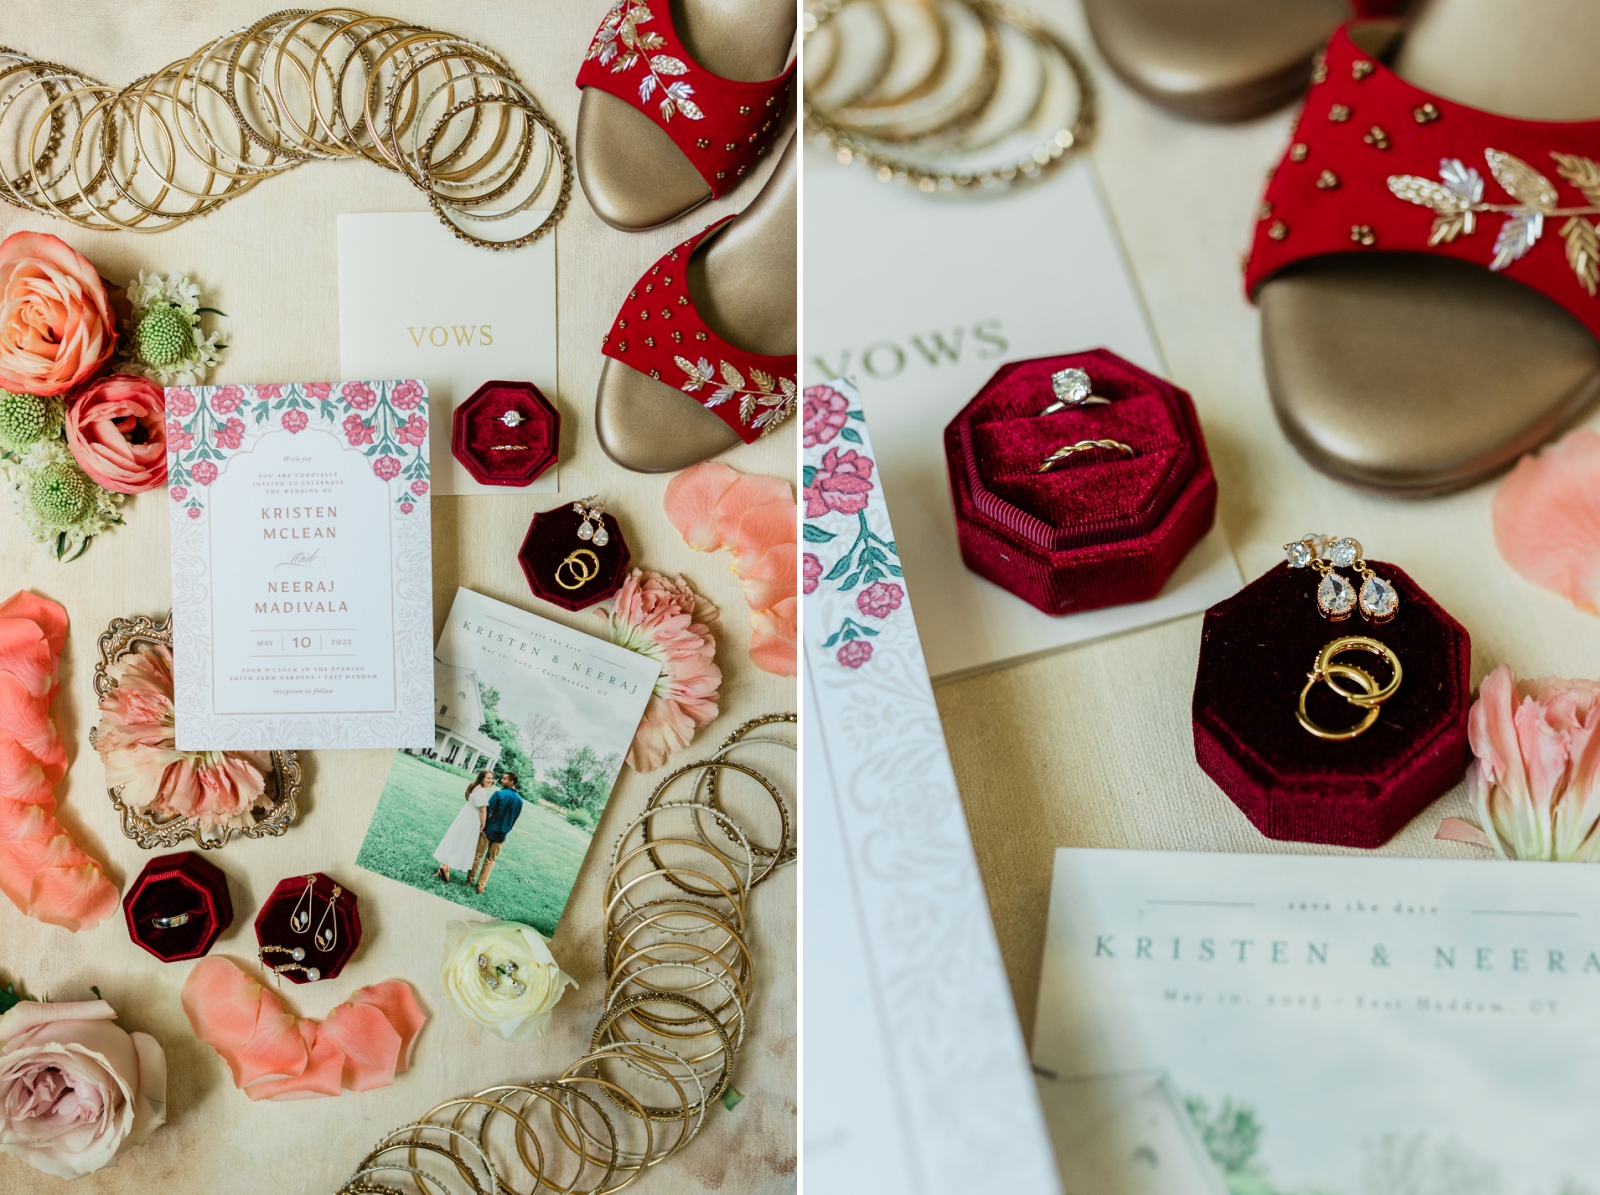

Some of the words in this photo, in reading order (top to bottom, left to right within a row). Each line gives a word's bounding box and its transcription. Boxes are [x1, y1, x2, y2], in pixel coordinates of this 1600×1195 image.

[406, 324, 494, 347] VOWS
[810, 318, 1009, 381] VOWS
[301, 455, 312, 463] joy
[261, 506, 337, 519] KRISTEN
[263, 527, 336, 539] MCLEAN
[268, 581, 334, 593] NEERAJ
[255, 601, 348, 614] MADIVALA
[292, 637, 312, 648] 10
[463, 621, 541, 656] KRISTEN
[551, 654, 559, 664] &
[572, 662, 638, 694] NEERAJ
[1094, 934, 1329, 965] KRISTEN
[1371, 943, 1391, 969] &
